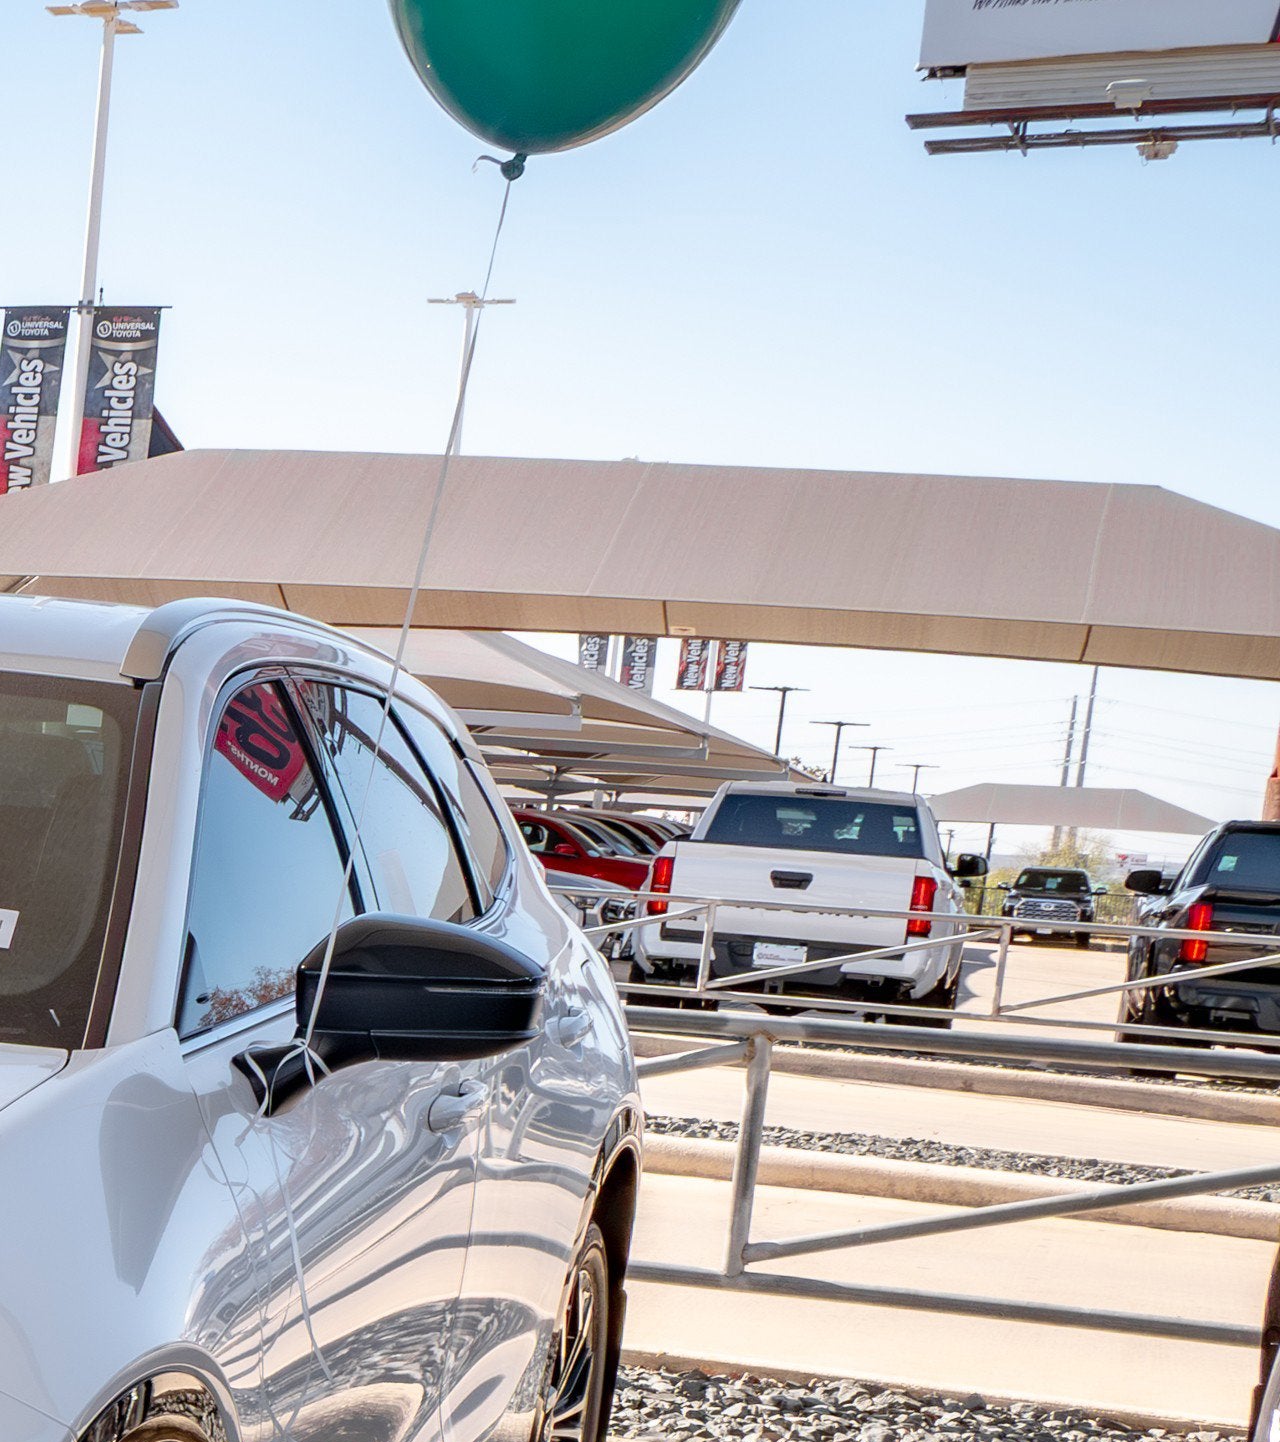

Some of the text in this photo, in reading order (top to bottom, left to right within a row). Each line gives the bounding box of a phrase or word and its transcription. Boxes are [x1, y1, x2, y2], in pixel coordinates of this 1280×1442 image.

[21, 320, 64, 329] UNIVERSAL
[21, 328, 50, 336] TOYOTA
[112, 322, 155, 330] UNIVERSAL
[112, 330, 141, 338] TOYOTA
[4, 358, 44, 460] Vehicles
[96, 361, 138, 463] Vehicles
[628, 638, 649, 689] Vehicles
[683, 664, 699, 686] New
[721, 665, 737, 687] New
